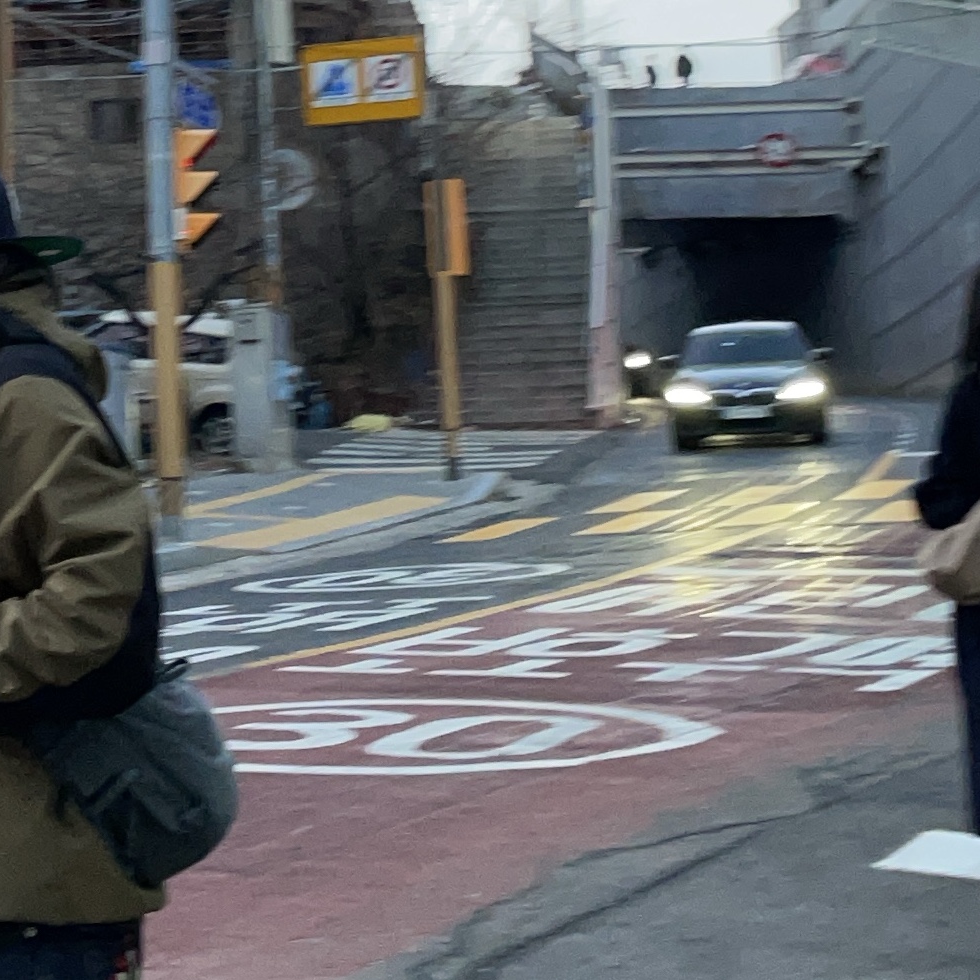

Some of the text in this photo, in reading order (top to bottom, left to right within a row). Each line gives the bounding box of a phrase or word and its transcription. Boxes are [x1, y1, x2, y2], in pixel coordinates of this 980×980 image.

[526, 583, 956, 621] 어린
[275, 626, 957, 692] 보호구역
[224, 708, 607, 760] 30
